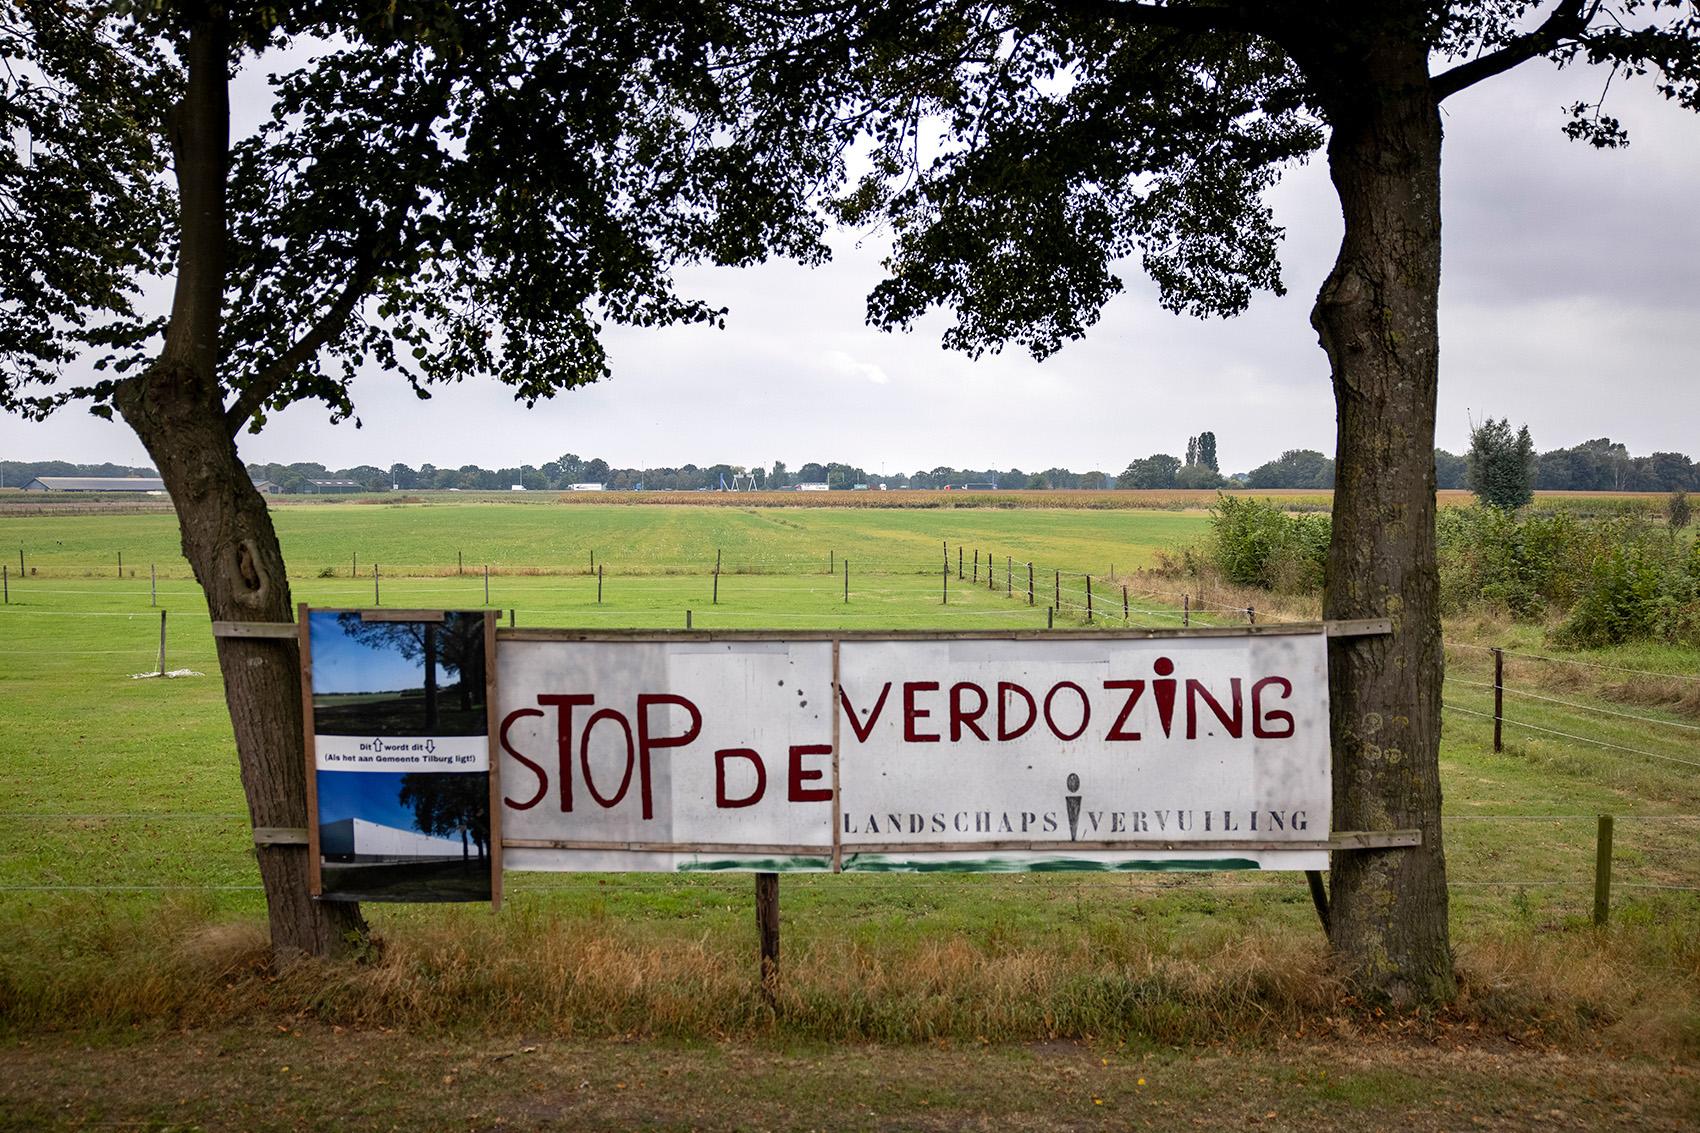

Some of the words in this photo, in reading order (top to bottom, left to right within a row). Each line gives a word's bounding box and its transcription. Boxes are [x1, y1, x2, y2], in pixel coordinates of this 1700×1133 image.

[360, 743, 372, 751] Dit
[325, 753, 341, 761] (Als
[342, 754, 356, 762] het
[422, 755, 453, 764] Tilburg
[499, 693, 703, 820] STOP
[714, 744, 834, 808] DE
